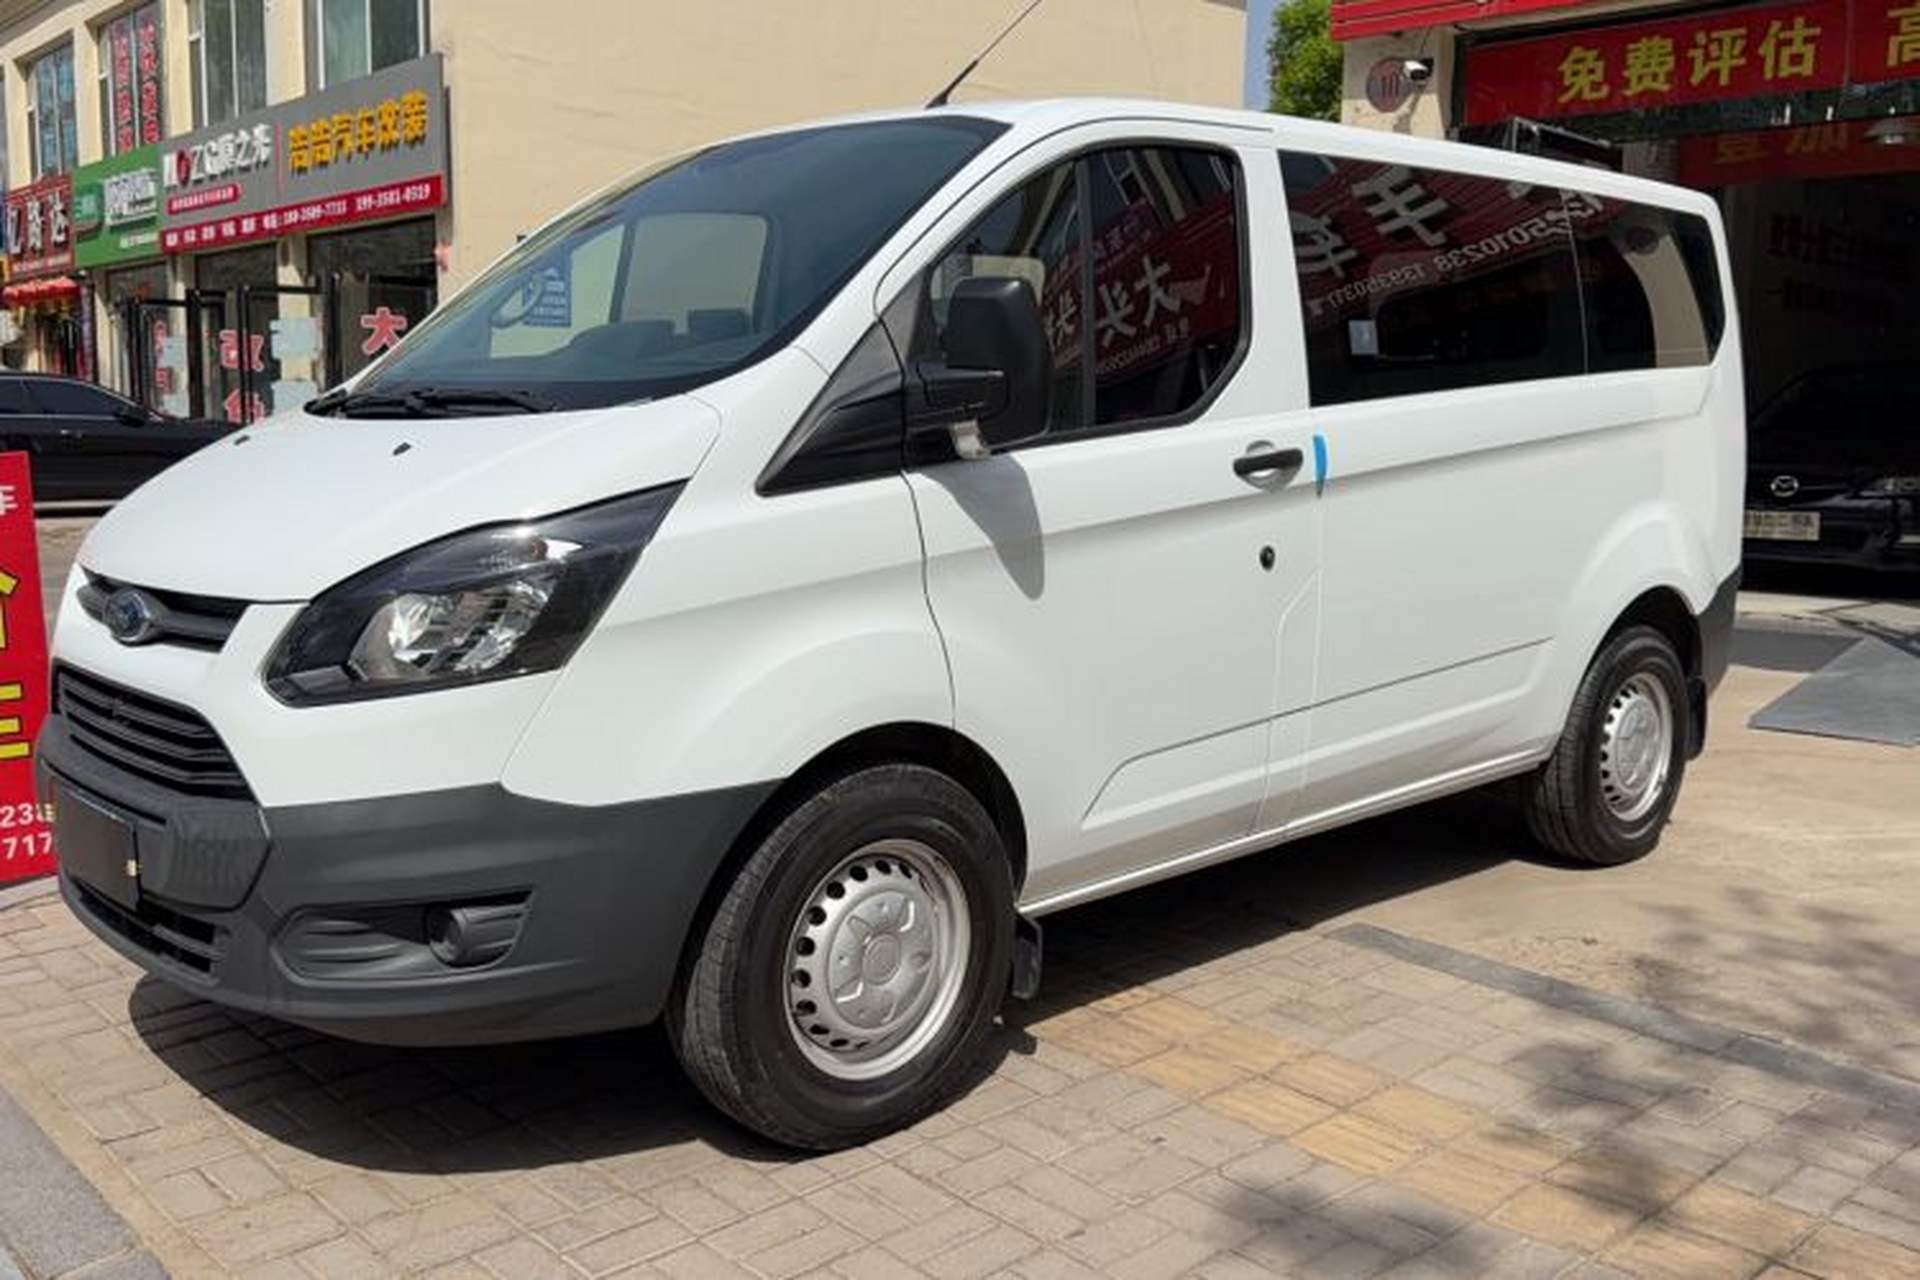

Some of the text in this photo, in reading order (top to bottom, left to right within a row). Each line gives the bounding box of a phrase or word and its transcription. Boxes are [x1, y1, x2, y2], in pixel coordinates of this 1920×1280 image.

[1558, 19, 1821, 103] 免费评估
[2, 831, 53, 861] 717
